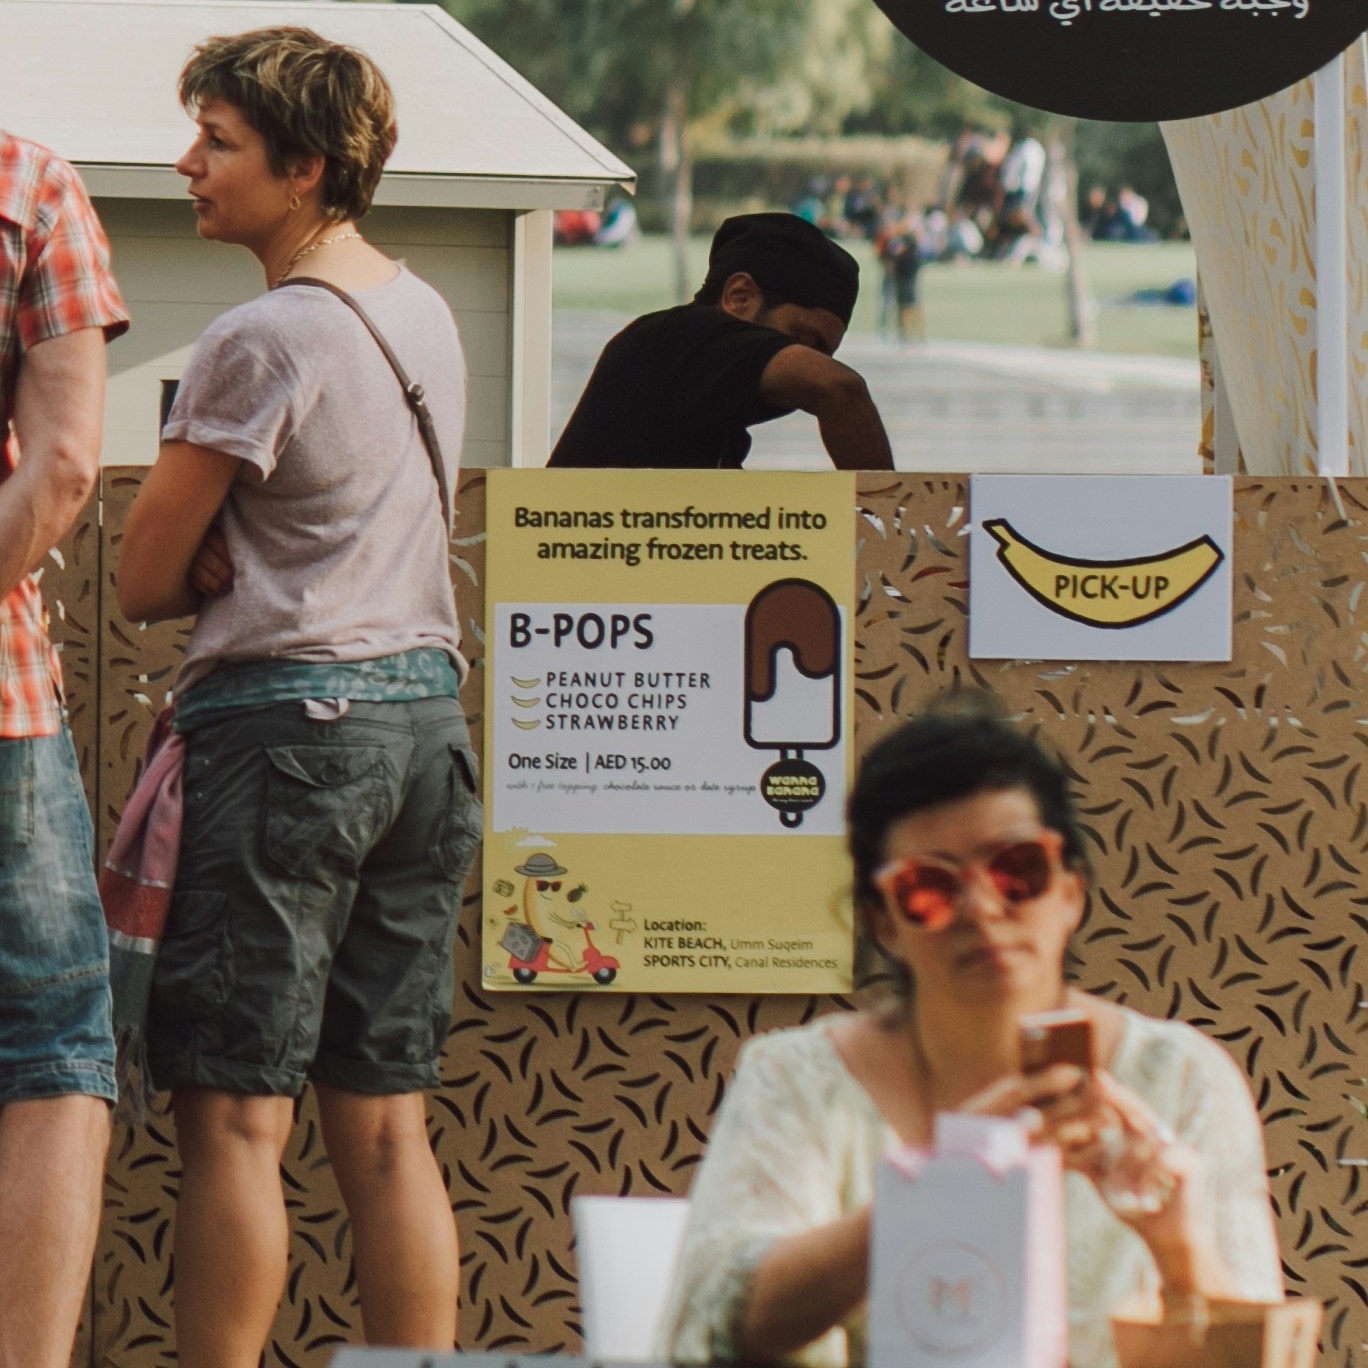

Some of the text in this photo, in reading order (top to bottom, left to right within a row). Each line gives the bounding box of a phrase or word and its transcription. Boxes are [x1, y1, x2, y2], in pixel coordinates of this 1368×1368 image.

[514, 505, 827, 530] Bananas transformed into
[536, 537, 808, 566] amazing frozen treats.
[1054, 574, 1170, 599] PICK-UP
[510, 612, 654, 650] B-POPS
[546, 672, 711, 689] PEANUT BUTTER
[545, 692, 688, 710] CHOCO CHIPS
[545, 714, 680, 731] STRAWBERRY
[508, 752, 672, 773] One Size AED 15.00
[644, 918, 707, 932] Location:
[644, 937, 813, 953] KITE BEACH, Umm Suqeim
[643, 955, 838, 970] SPORTS CITY, Canal Residences
